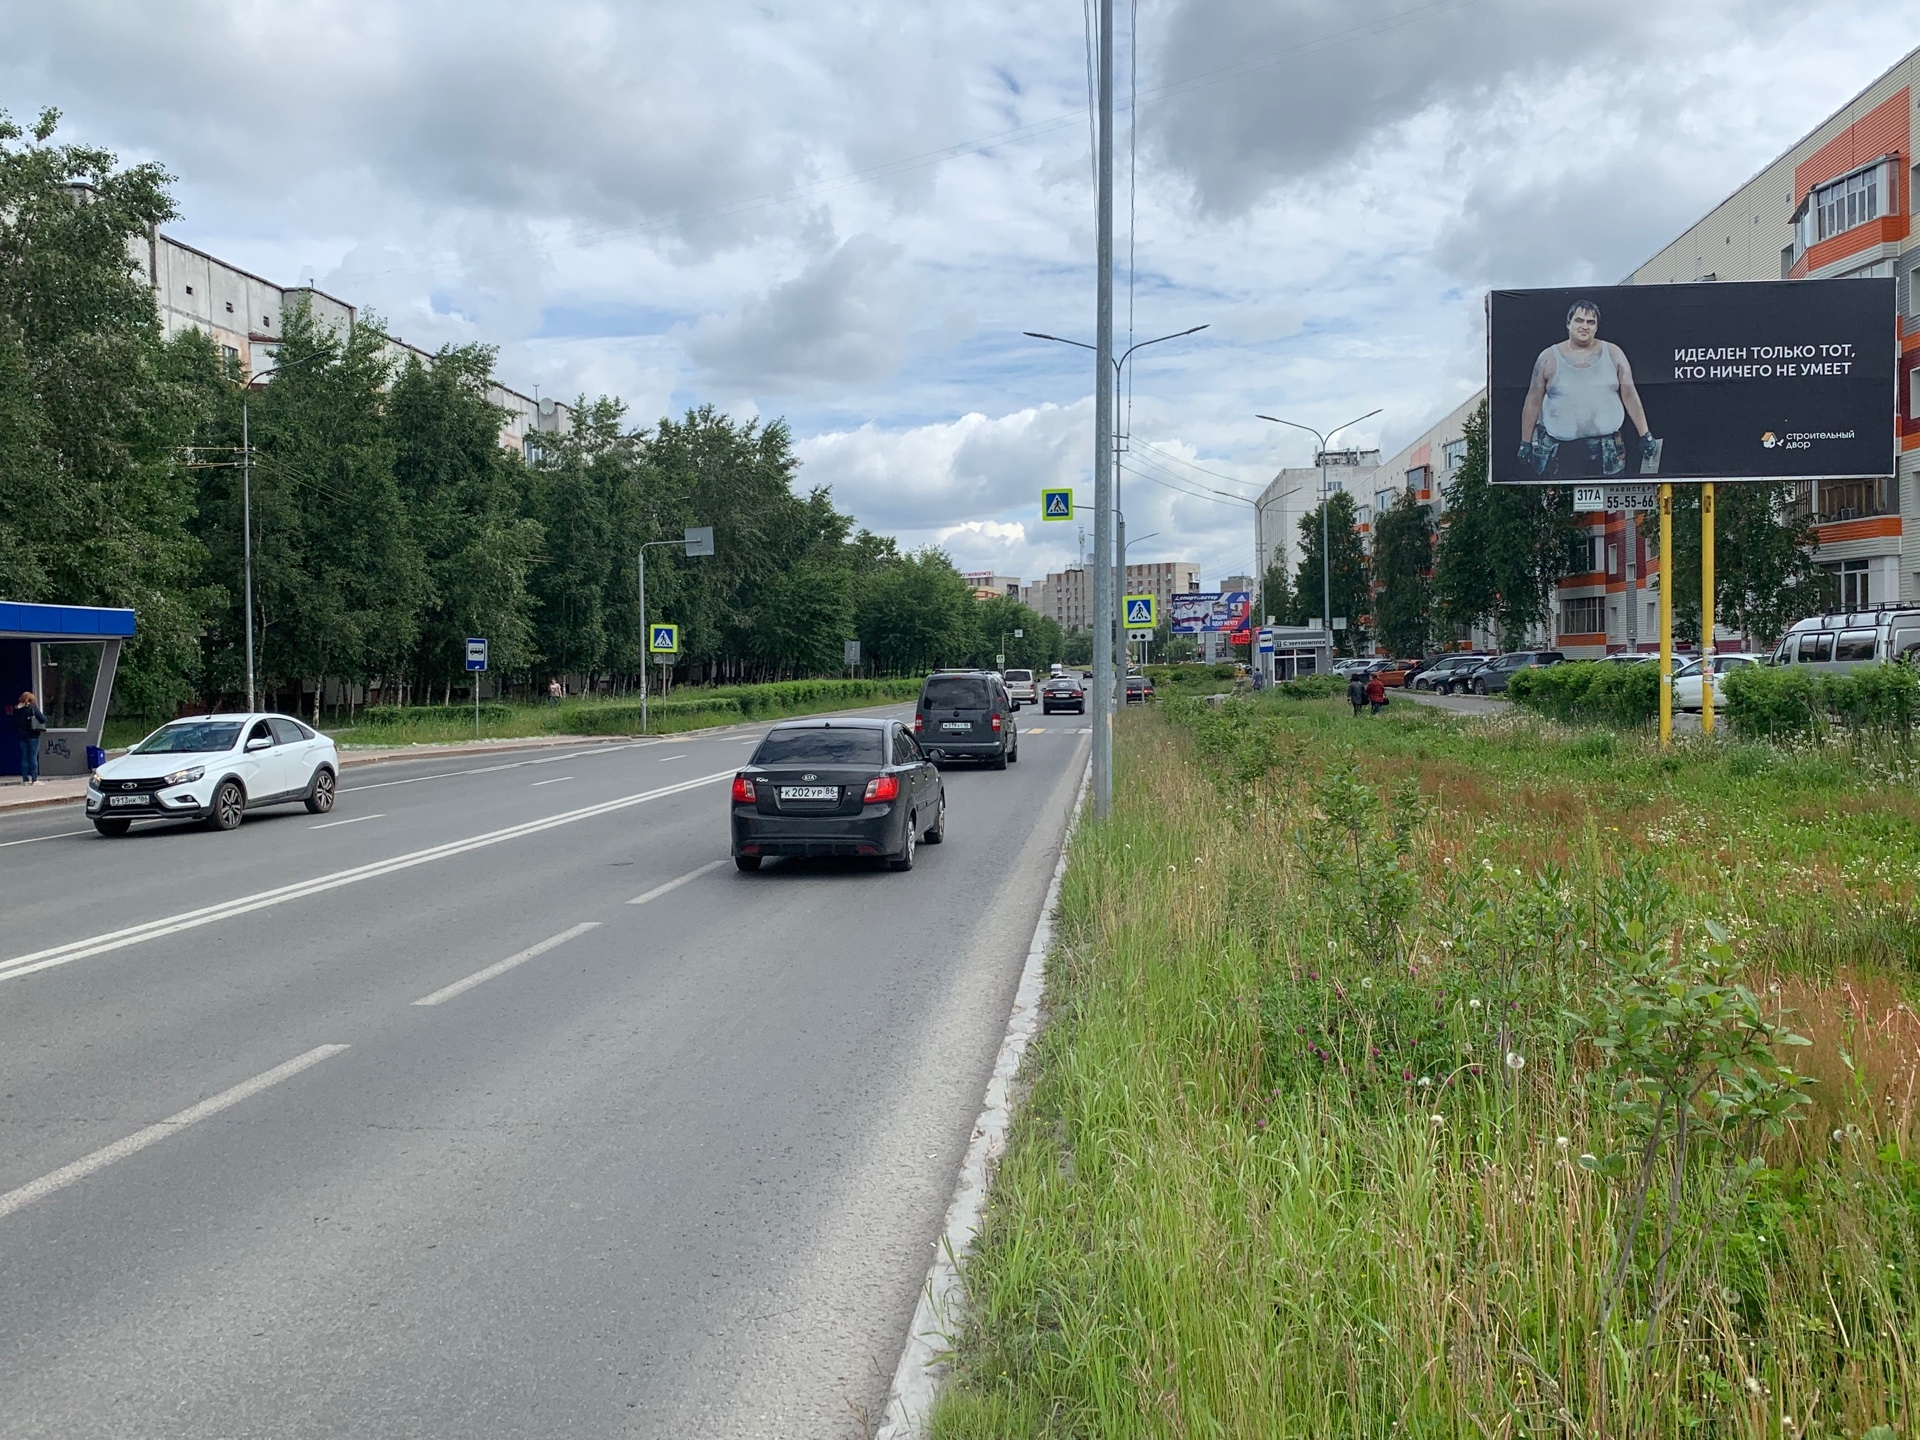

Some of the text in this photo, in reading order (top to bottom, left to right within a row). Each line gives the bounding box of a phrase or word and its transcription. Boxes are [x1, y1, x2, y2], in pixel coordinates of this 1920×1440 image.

[1674, 344, 1856, 363] ИДЕАЛЕН ТОЛЬКО ТОТ,
[1674, 362, 1852, 379] КТО НИЧЕГО НЕ УМЕЕТ
[1785, 429, 1855, 441] строительный
[1785, 441, 1811, 450] двор
[1607, 495, 1654, 508] 55-55-66
